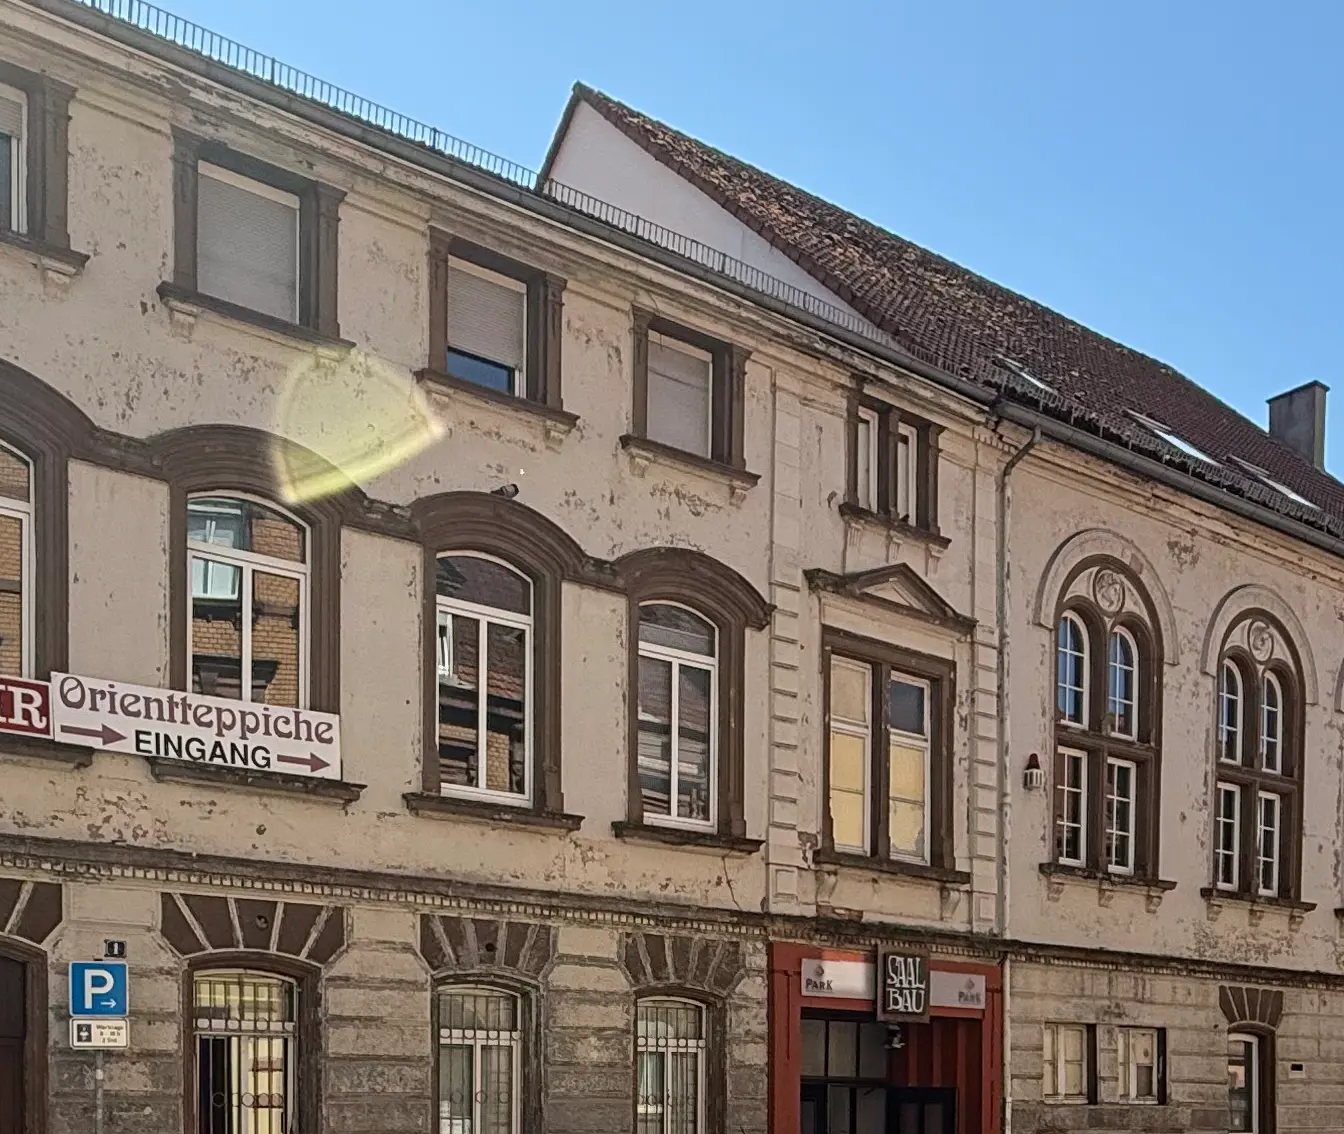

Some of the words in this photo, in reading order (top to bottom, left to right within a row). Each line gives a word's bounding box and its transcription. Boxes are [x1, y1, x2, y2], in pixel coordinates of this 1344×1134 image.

[59, 675, 334, 745] Orientteppiche
[134, 729, 272, 769] EINGANG
[84, 968, 115, 1010] P
[887, 955, 926, 989] SAAL
[887, 987, 925, 1014] BAU
